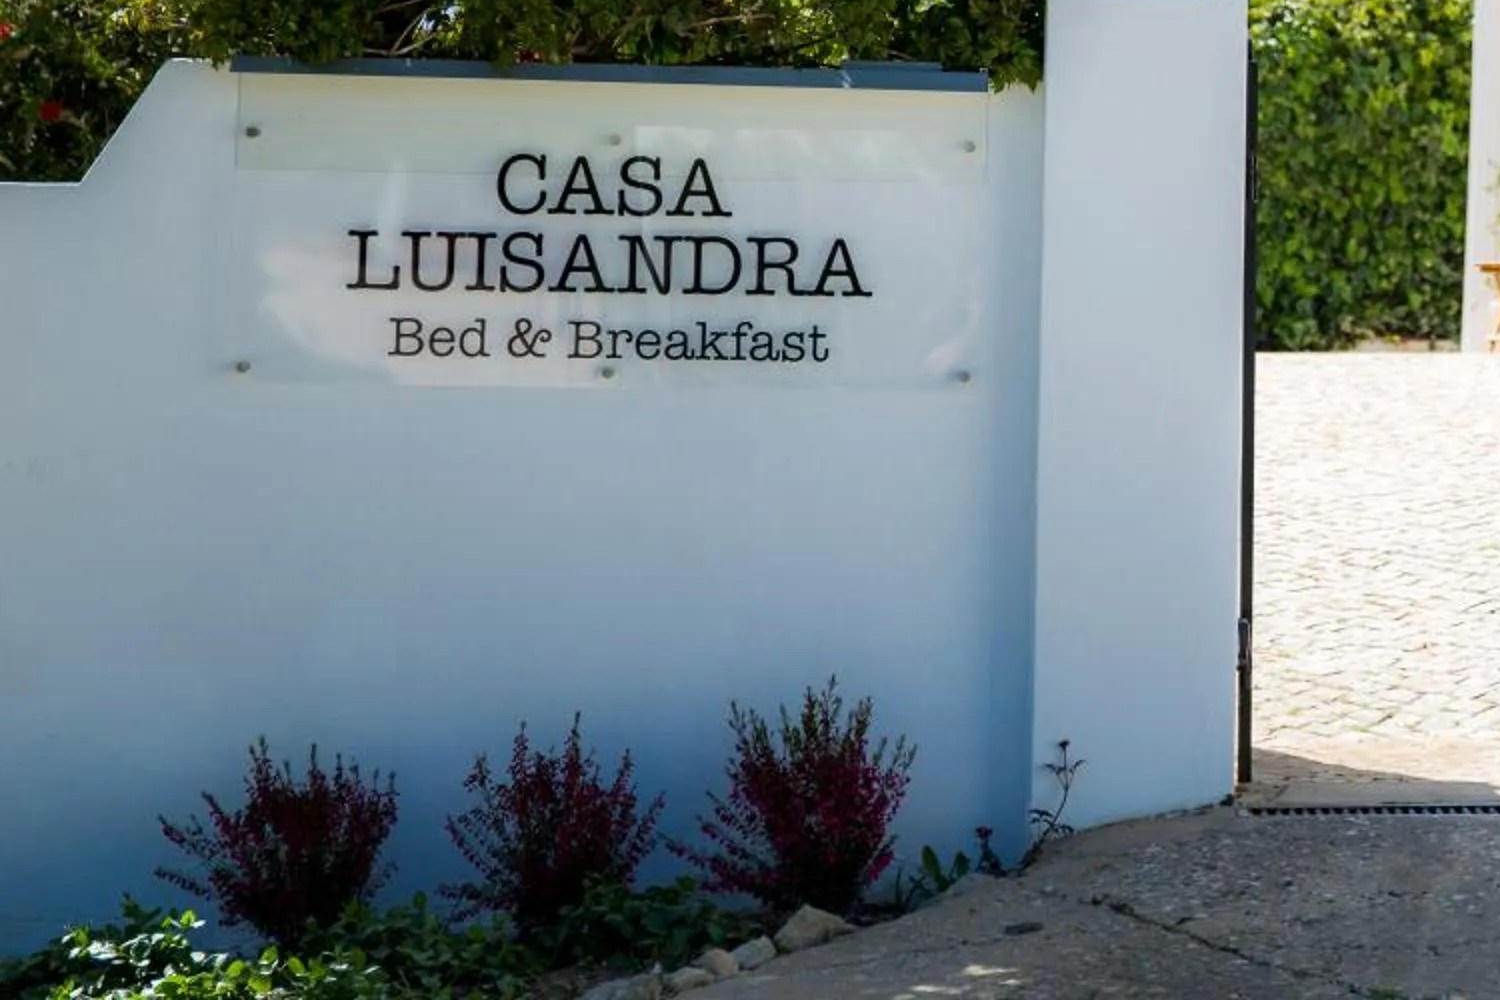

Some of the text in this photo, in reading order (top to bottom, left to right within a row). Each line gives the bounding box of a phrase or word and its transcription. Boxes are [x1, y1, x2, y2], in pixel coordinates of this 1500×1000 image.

[496, 152, 733, 218] CASA
[345, 228, 874, 298] LUISANDRA
[387, 317, 830, 363] Bed & Breakfast
